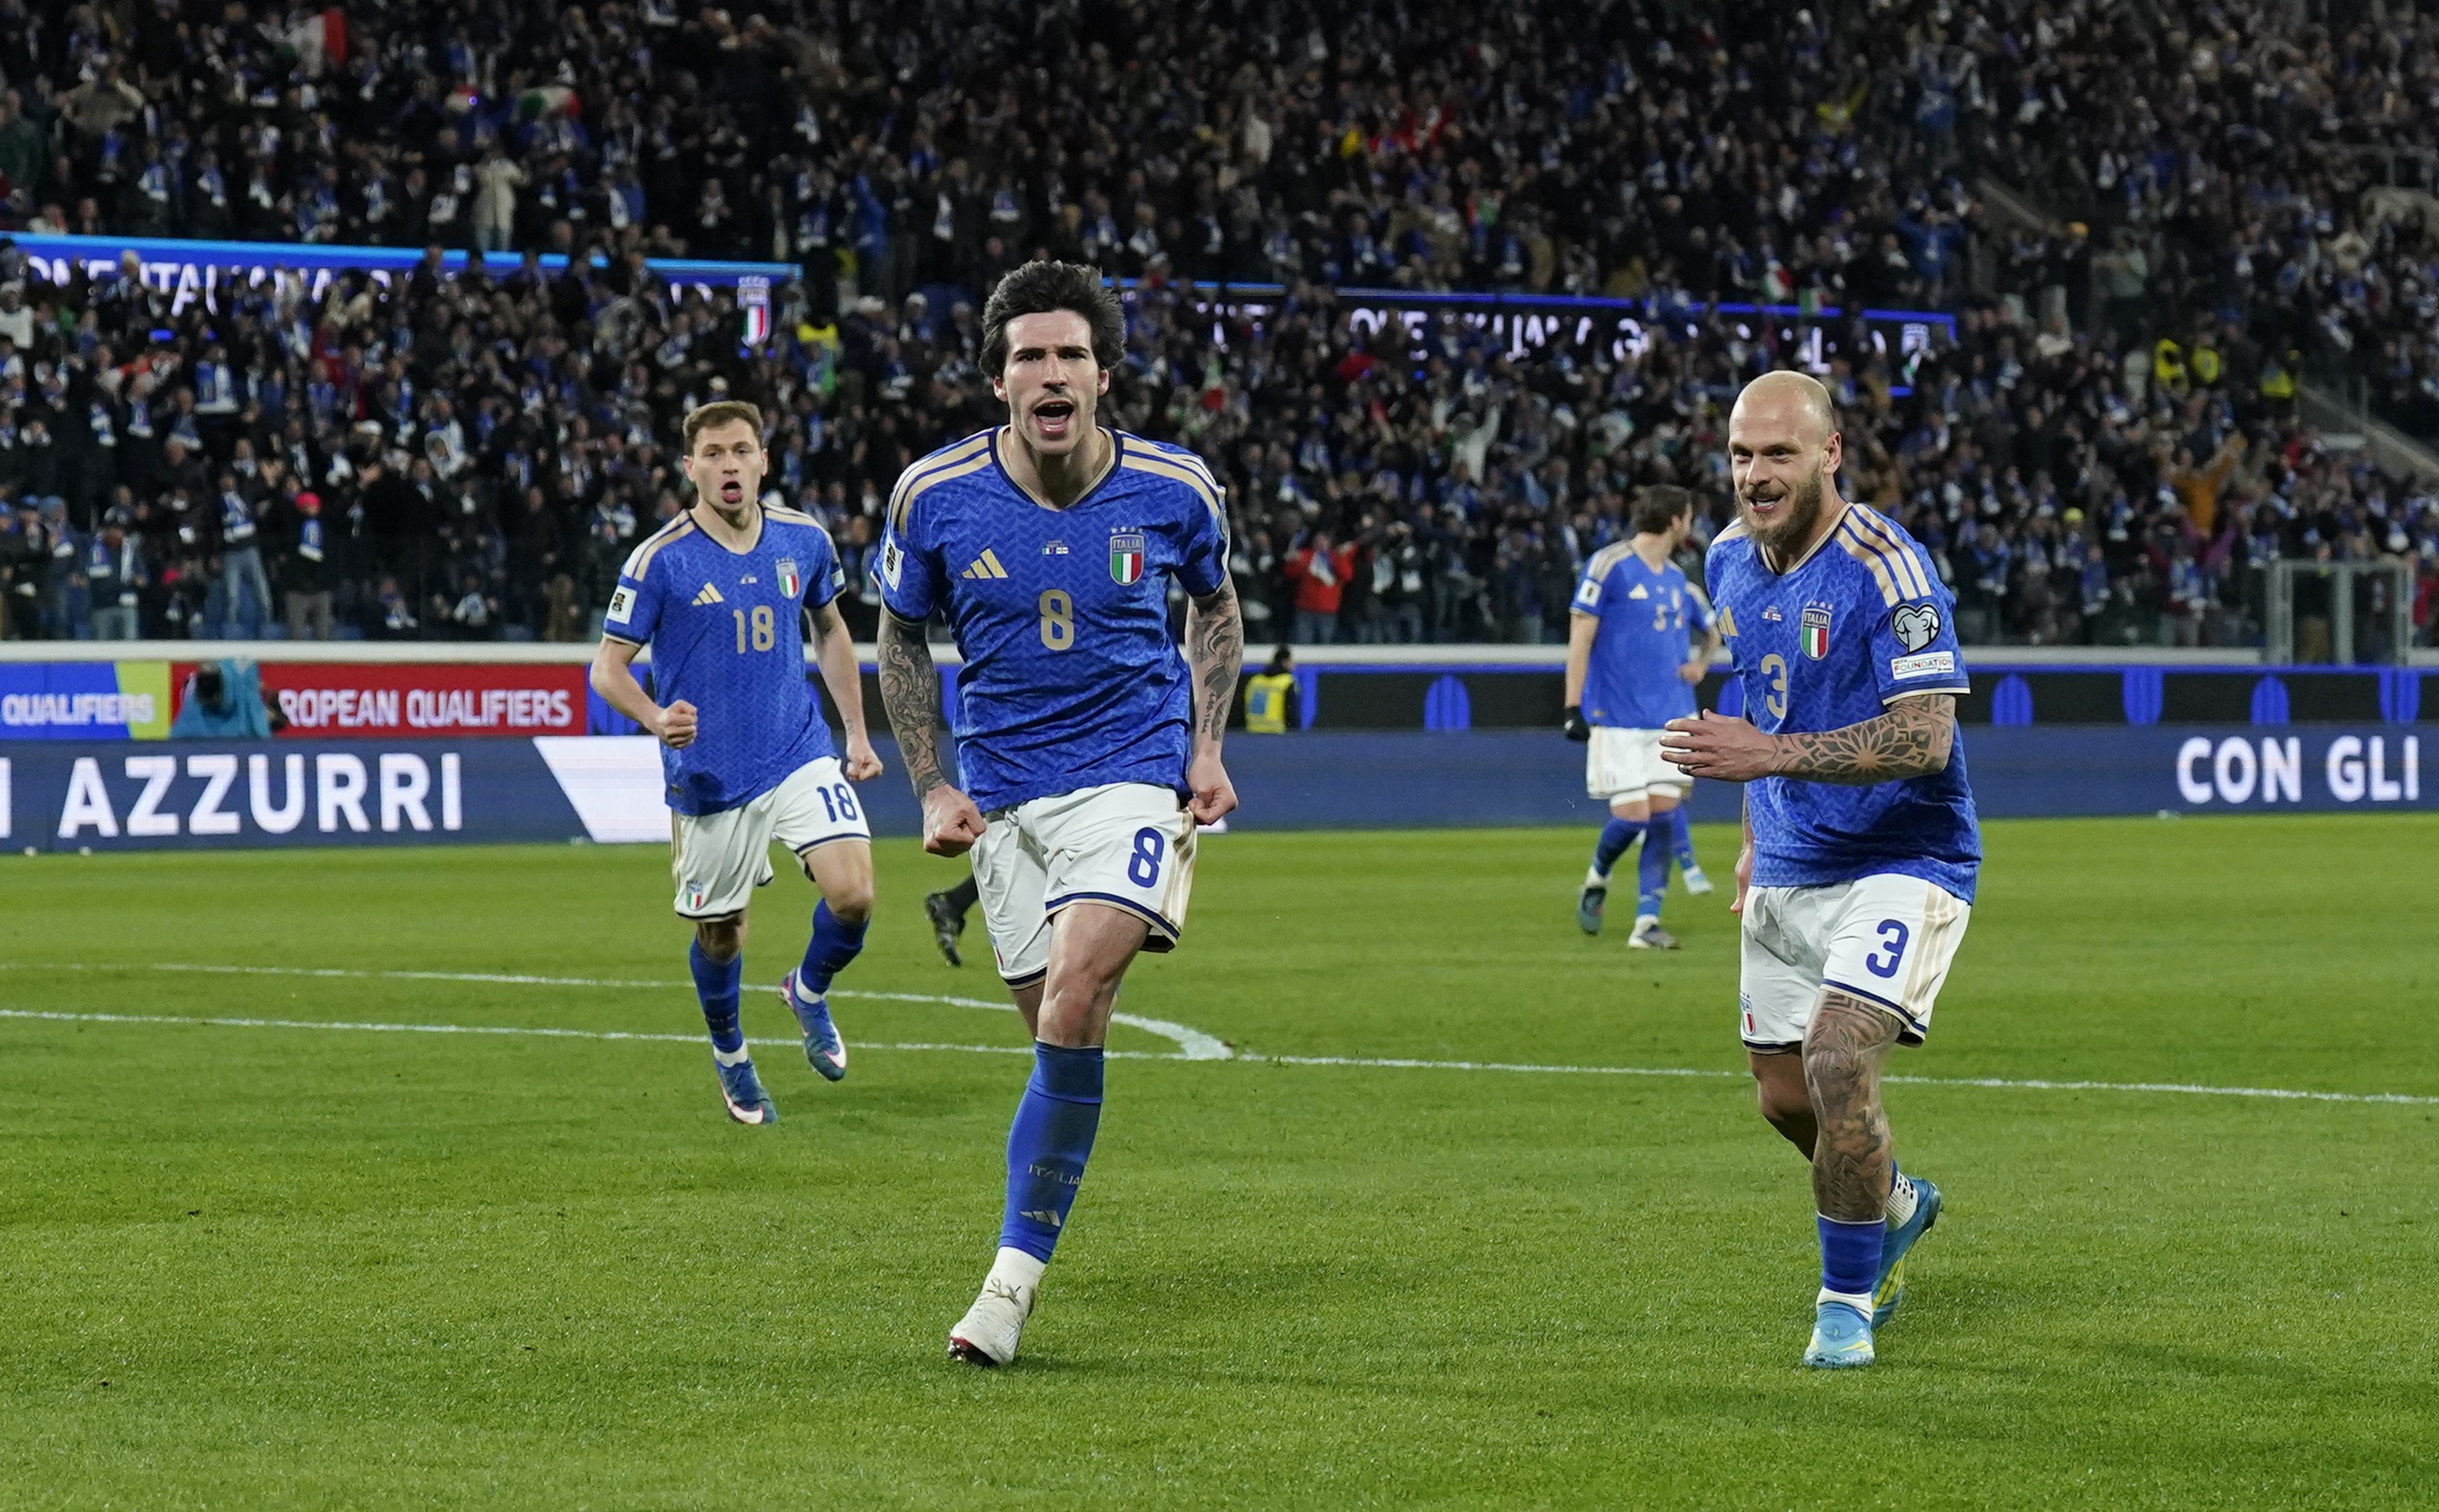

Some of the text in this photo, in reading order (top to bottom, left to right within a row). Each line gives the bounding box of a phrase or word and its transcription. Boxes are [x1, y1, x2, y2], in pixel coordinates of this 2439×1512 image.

[1113, 538, 1141, 549] ITALIA
[733, 604, 775, 655] 18
[1039, 589, 1074, 651] 8
[1804, 612, 1828, 625] ITALIA
[1761, 653, 1788, 720] 3
[1894, 658, 1953, 671] FOUNDATION
[1, 692, 155, 726] QUALIFIERS
[278, 688, 573, 728] ROPEAN QUALIFIERS
[2176, 734, 2420, 804] CON GLI
[57, 753, 463, 838] AZZURRI
[816, 783, 858, 823] 18
[1128, 826, 1165, 888] 8
[1865, 918, 1909, 979] 3
